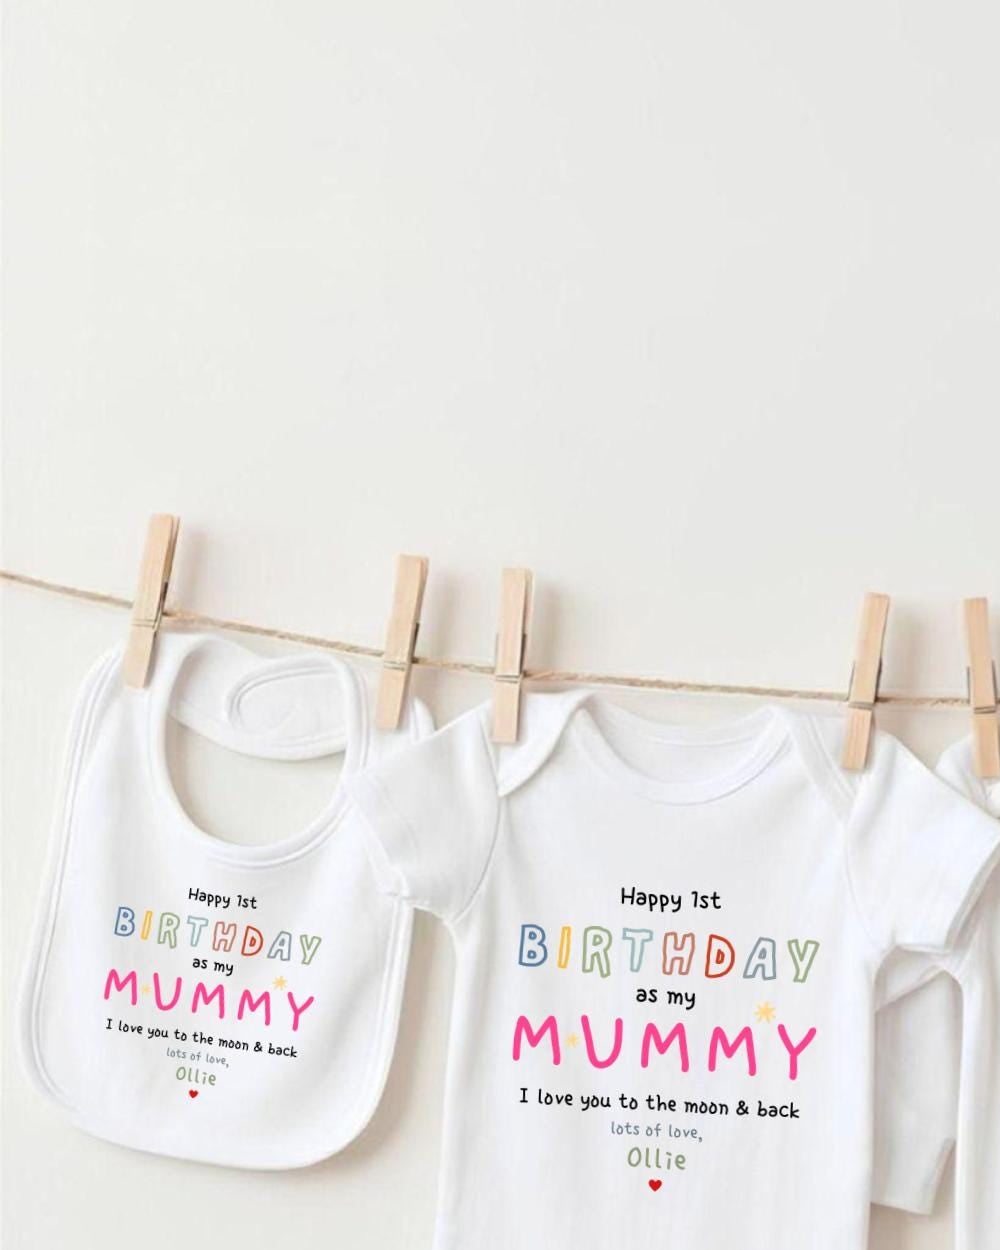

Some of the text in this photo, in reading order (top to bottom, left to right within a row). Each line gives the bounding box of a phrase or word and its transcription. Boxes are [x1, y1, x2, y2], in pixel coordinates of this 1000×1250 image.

[188, 888, 258, 909] Happy 1st
[620, 886, 722, 914] Happy 1st
[114, 906, 321, 965] BIRTHDAY
[517, 923, 821, 984] BIRTHDAY
[192, 958, 234, 977] as my
[104, 968, 314, 1032] MUMMY
[635, 987, 697, 1012] as my
[106, 1018, 298, 1058] I love you to the moon & back
[511, 1013, 818, 1082] MUMMY
[167, 1048, 229, 1068] lots of love,
[176, 1067, 216, 1086] Ollie
[519, 1087, 801, 1120] I love you to the moon & back
[610, 1120, 703, 1143] lots of love,
[626, 1146, 687, 1171] Ollie
